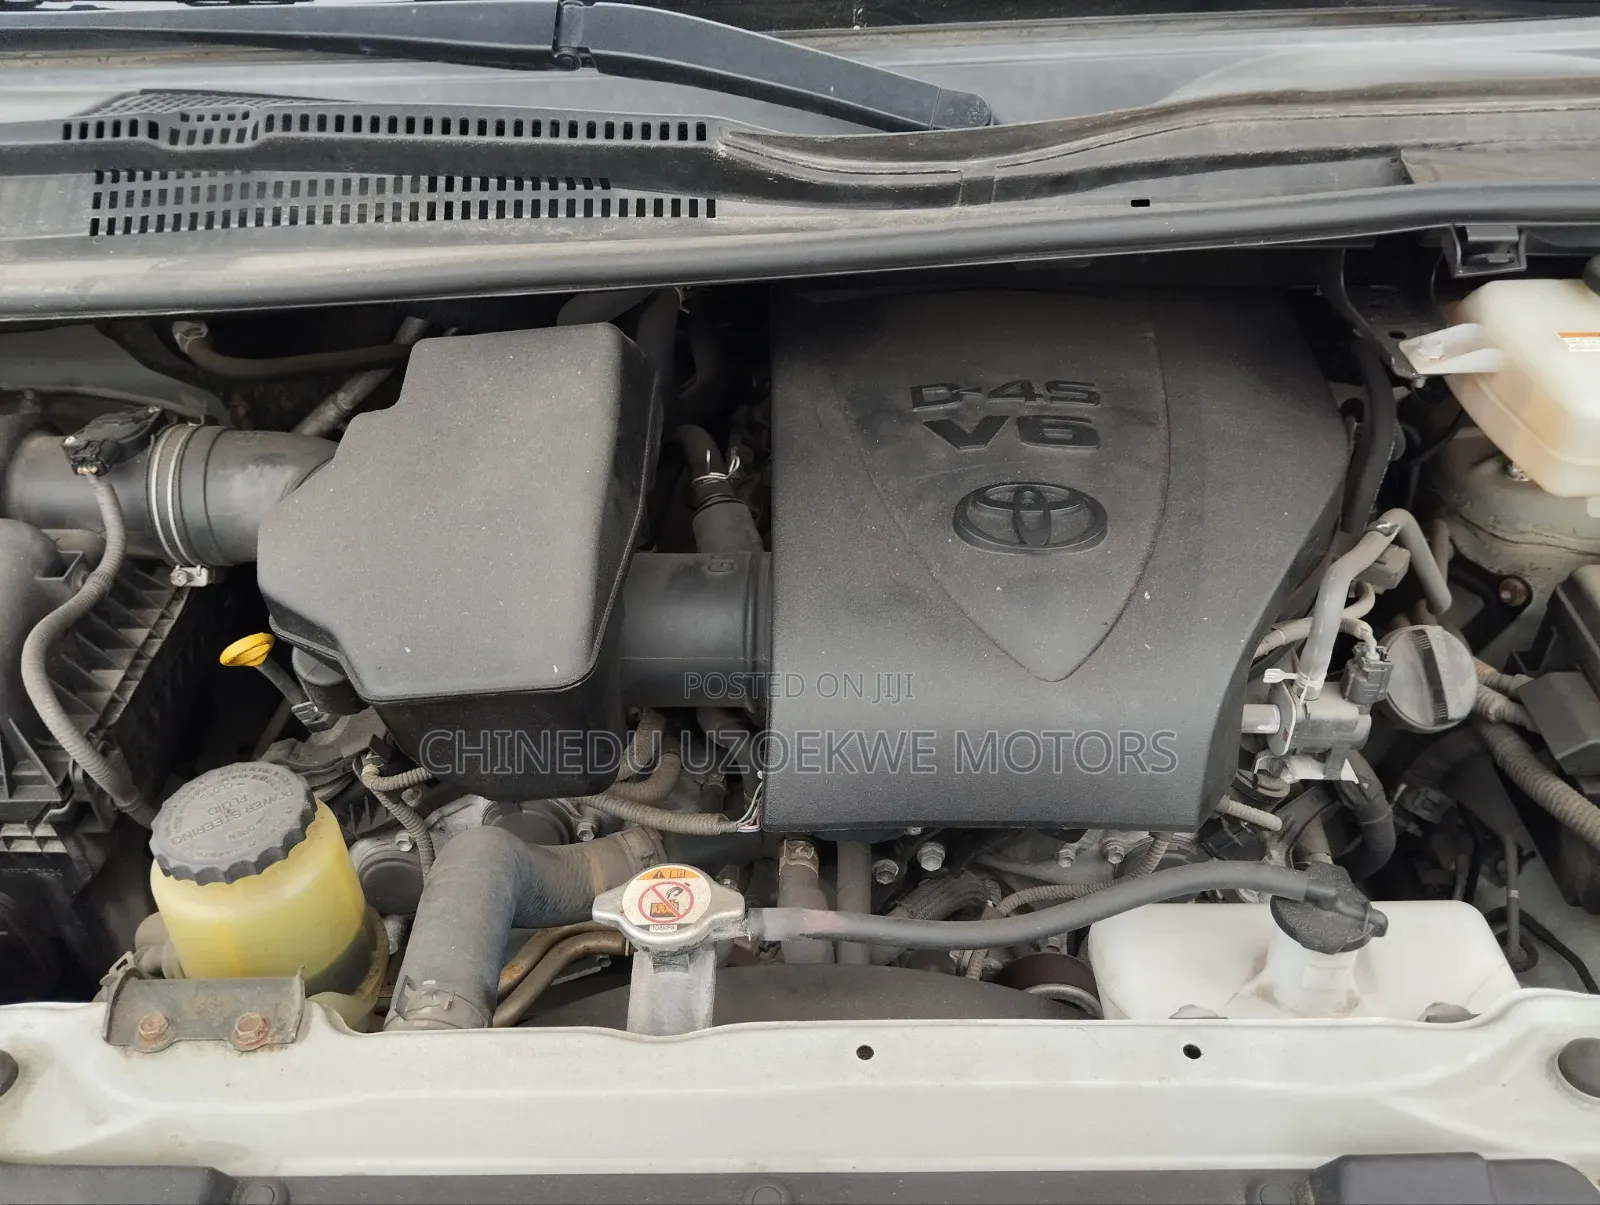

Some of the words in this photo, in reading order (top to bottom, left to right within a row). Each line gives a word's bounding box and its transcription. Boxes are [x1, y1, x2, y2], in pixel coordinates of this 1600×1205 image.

[910, 379, 1101, 412] D-4S
[922, 414, 1100, 451] V6
[206, 793, 250, 816] FLUID
[243, 788, 295, 814] POWER
[170, 809, 243, 846] STEERING
[227, 821, 258, 841] OPEN
